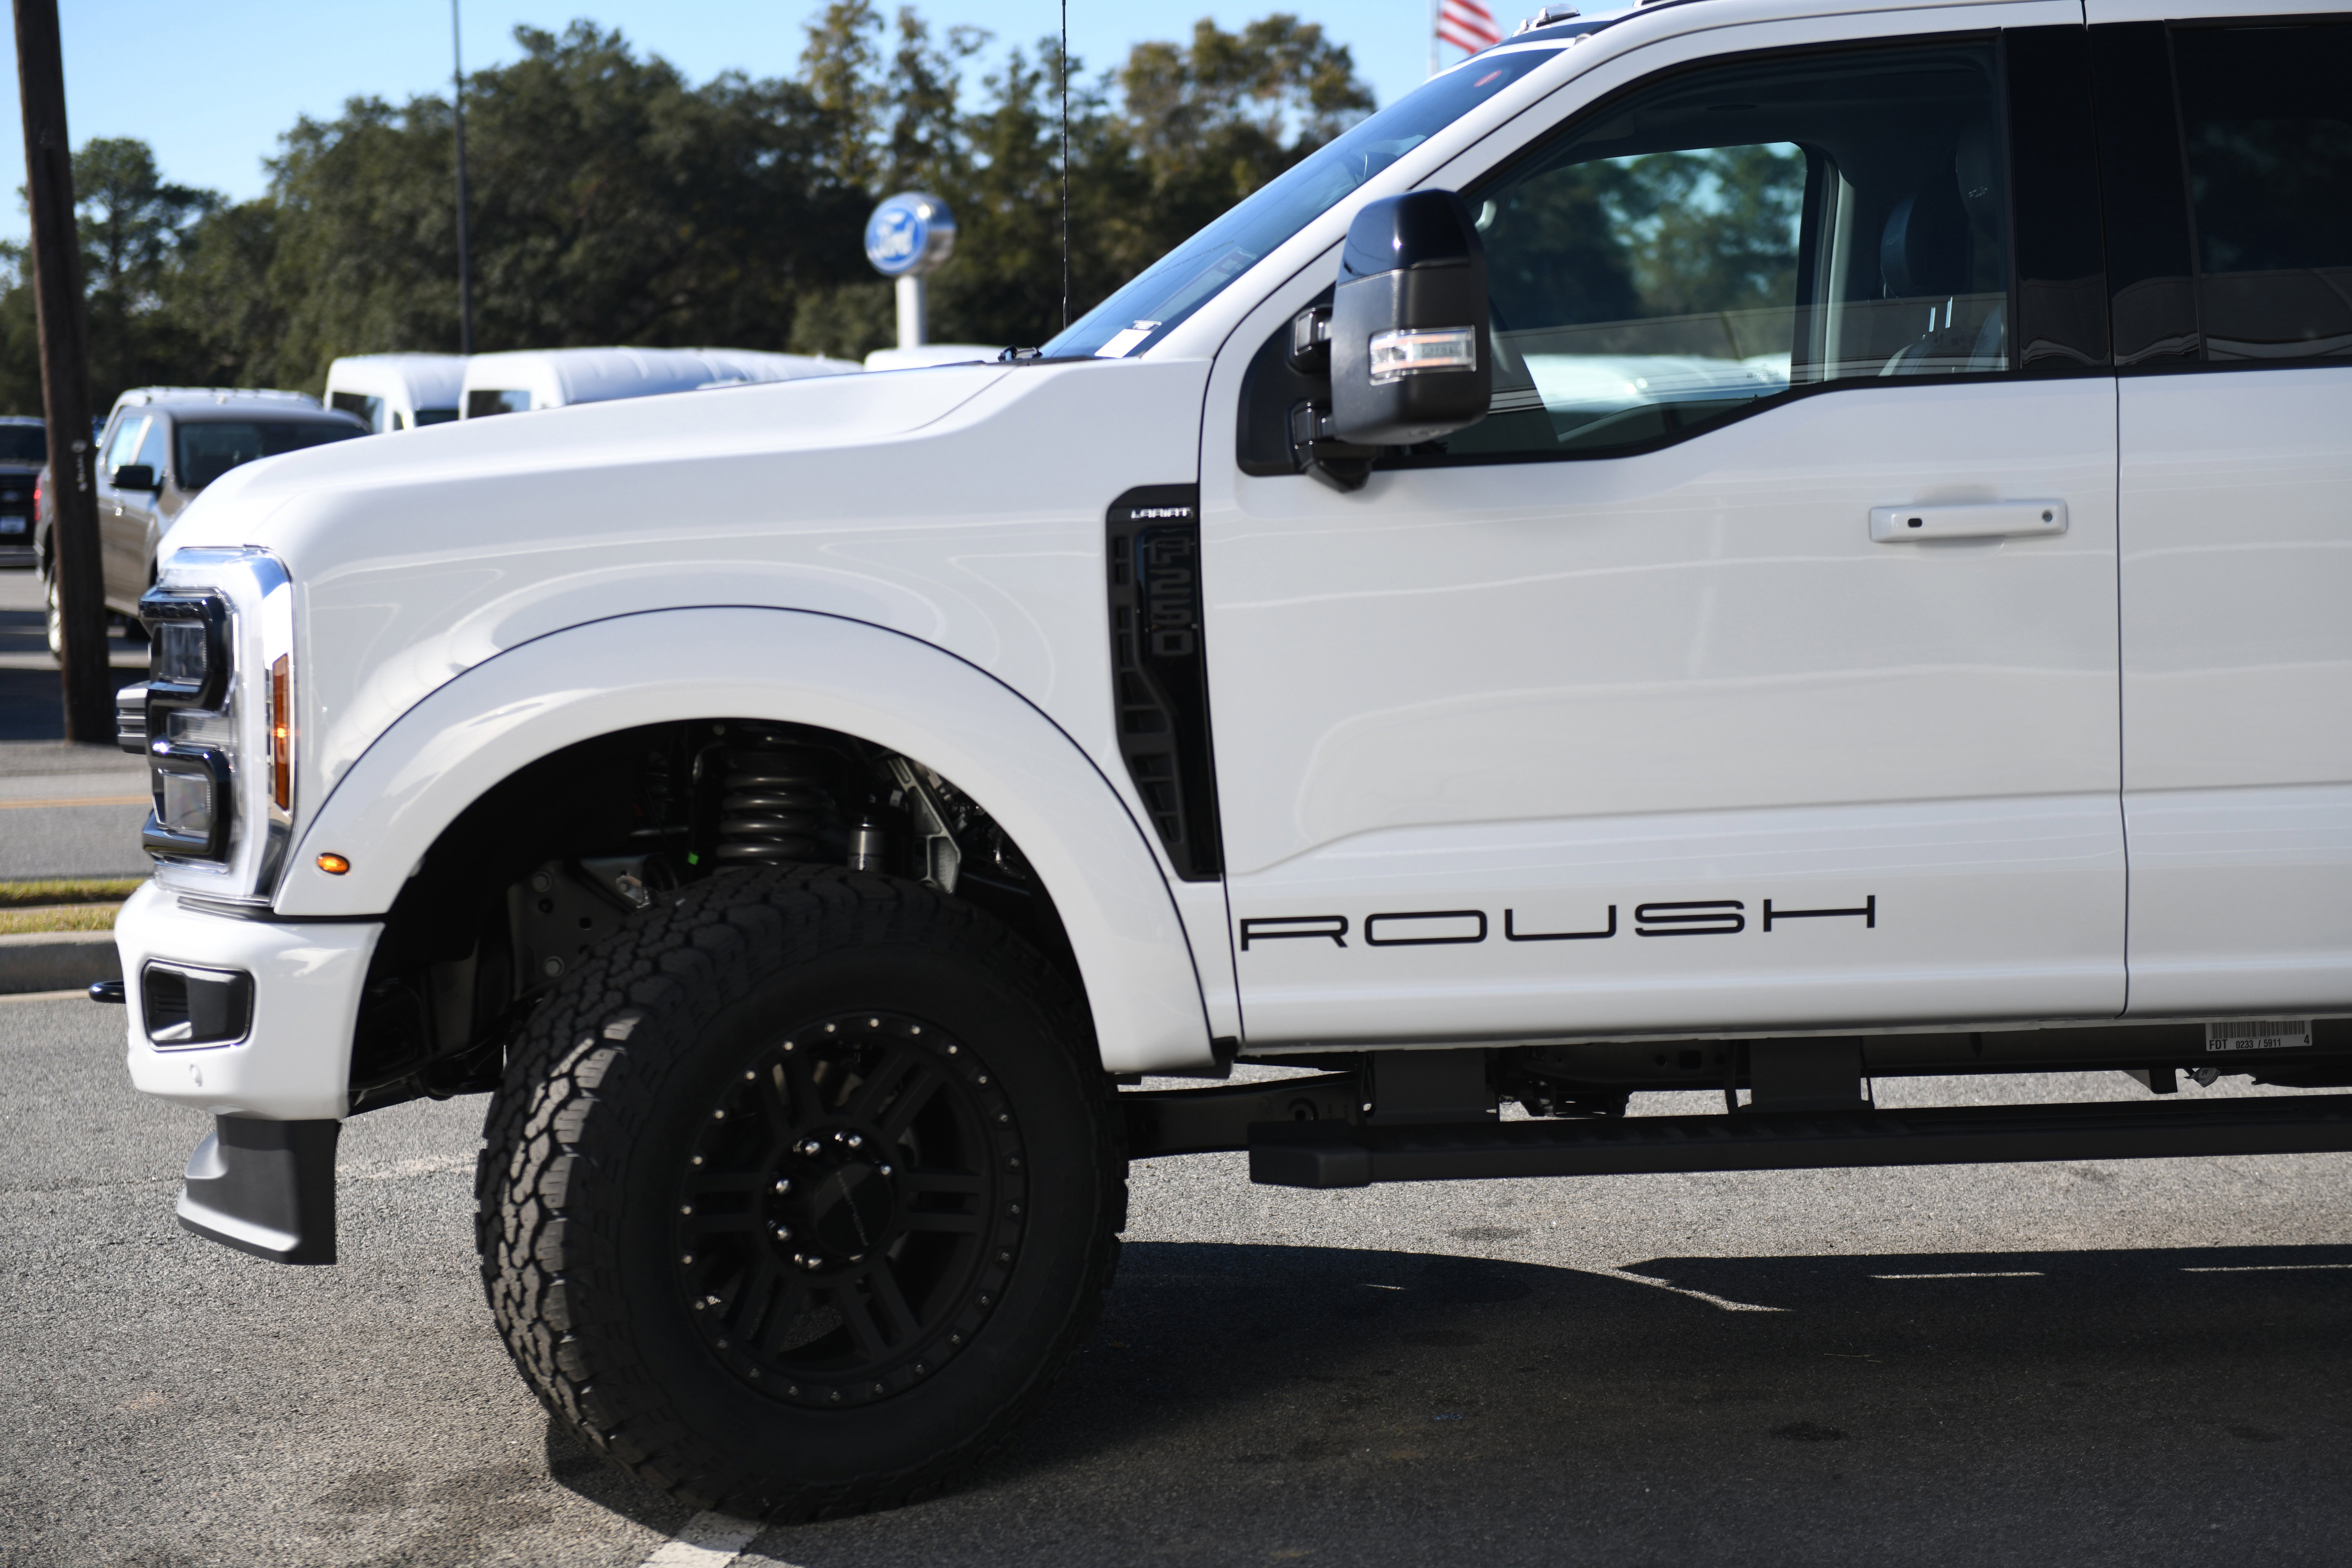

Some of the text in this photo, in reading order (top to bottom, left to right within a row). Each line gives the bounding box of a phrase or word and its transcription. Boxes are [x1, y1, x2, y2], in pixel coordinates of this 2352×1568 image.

[1131, 507, 1191, 519] LARIAT
[1240, 895, 1876, 951] ROUSH
[2209, 1040, 2227, 1049] FDT
[2236, 1040, 2253, 1049] 0233
[2264, 1039, 2281, 1047] 5911
[2304, 1035, 2310, 1044] 4
